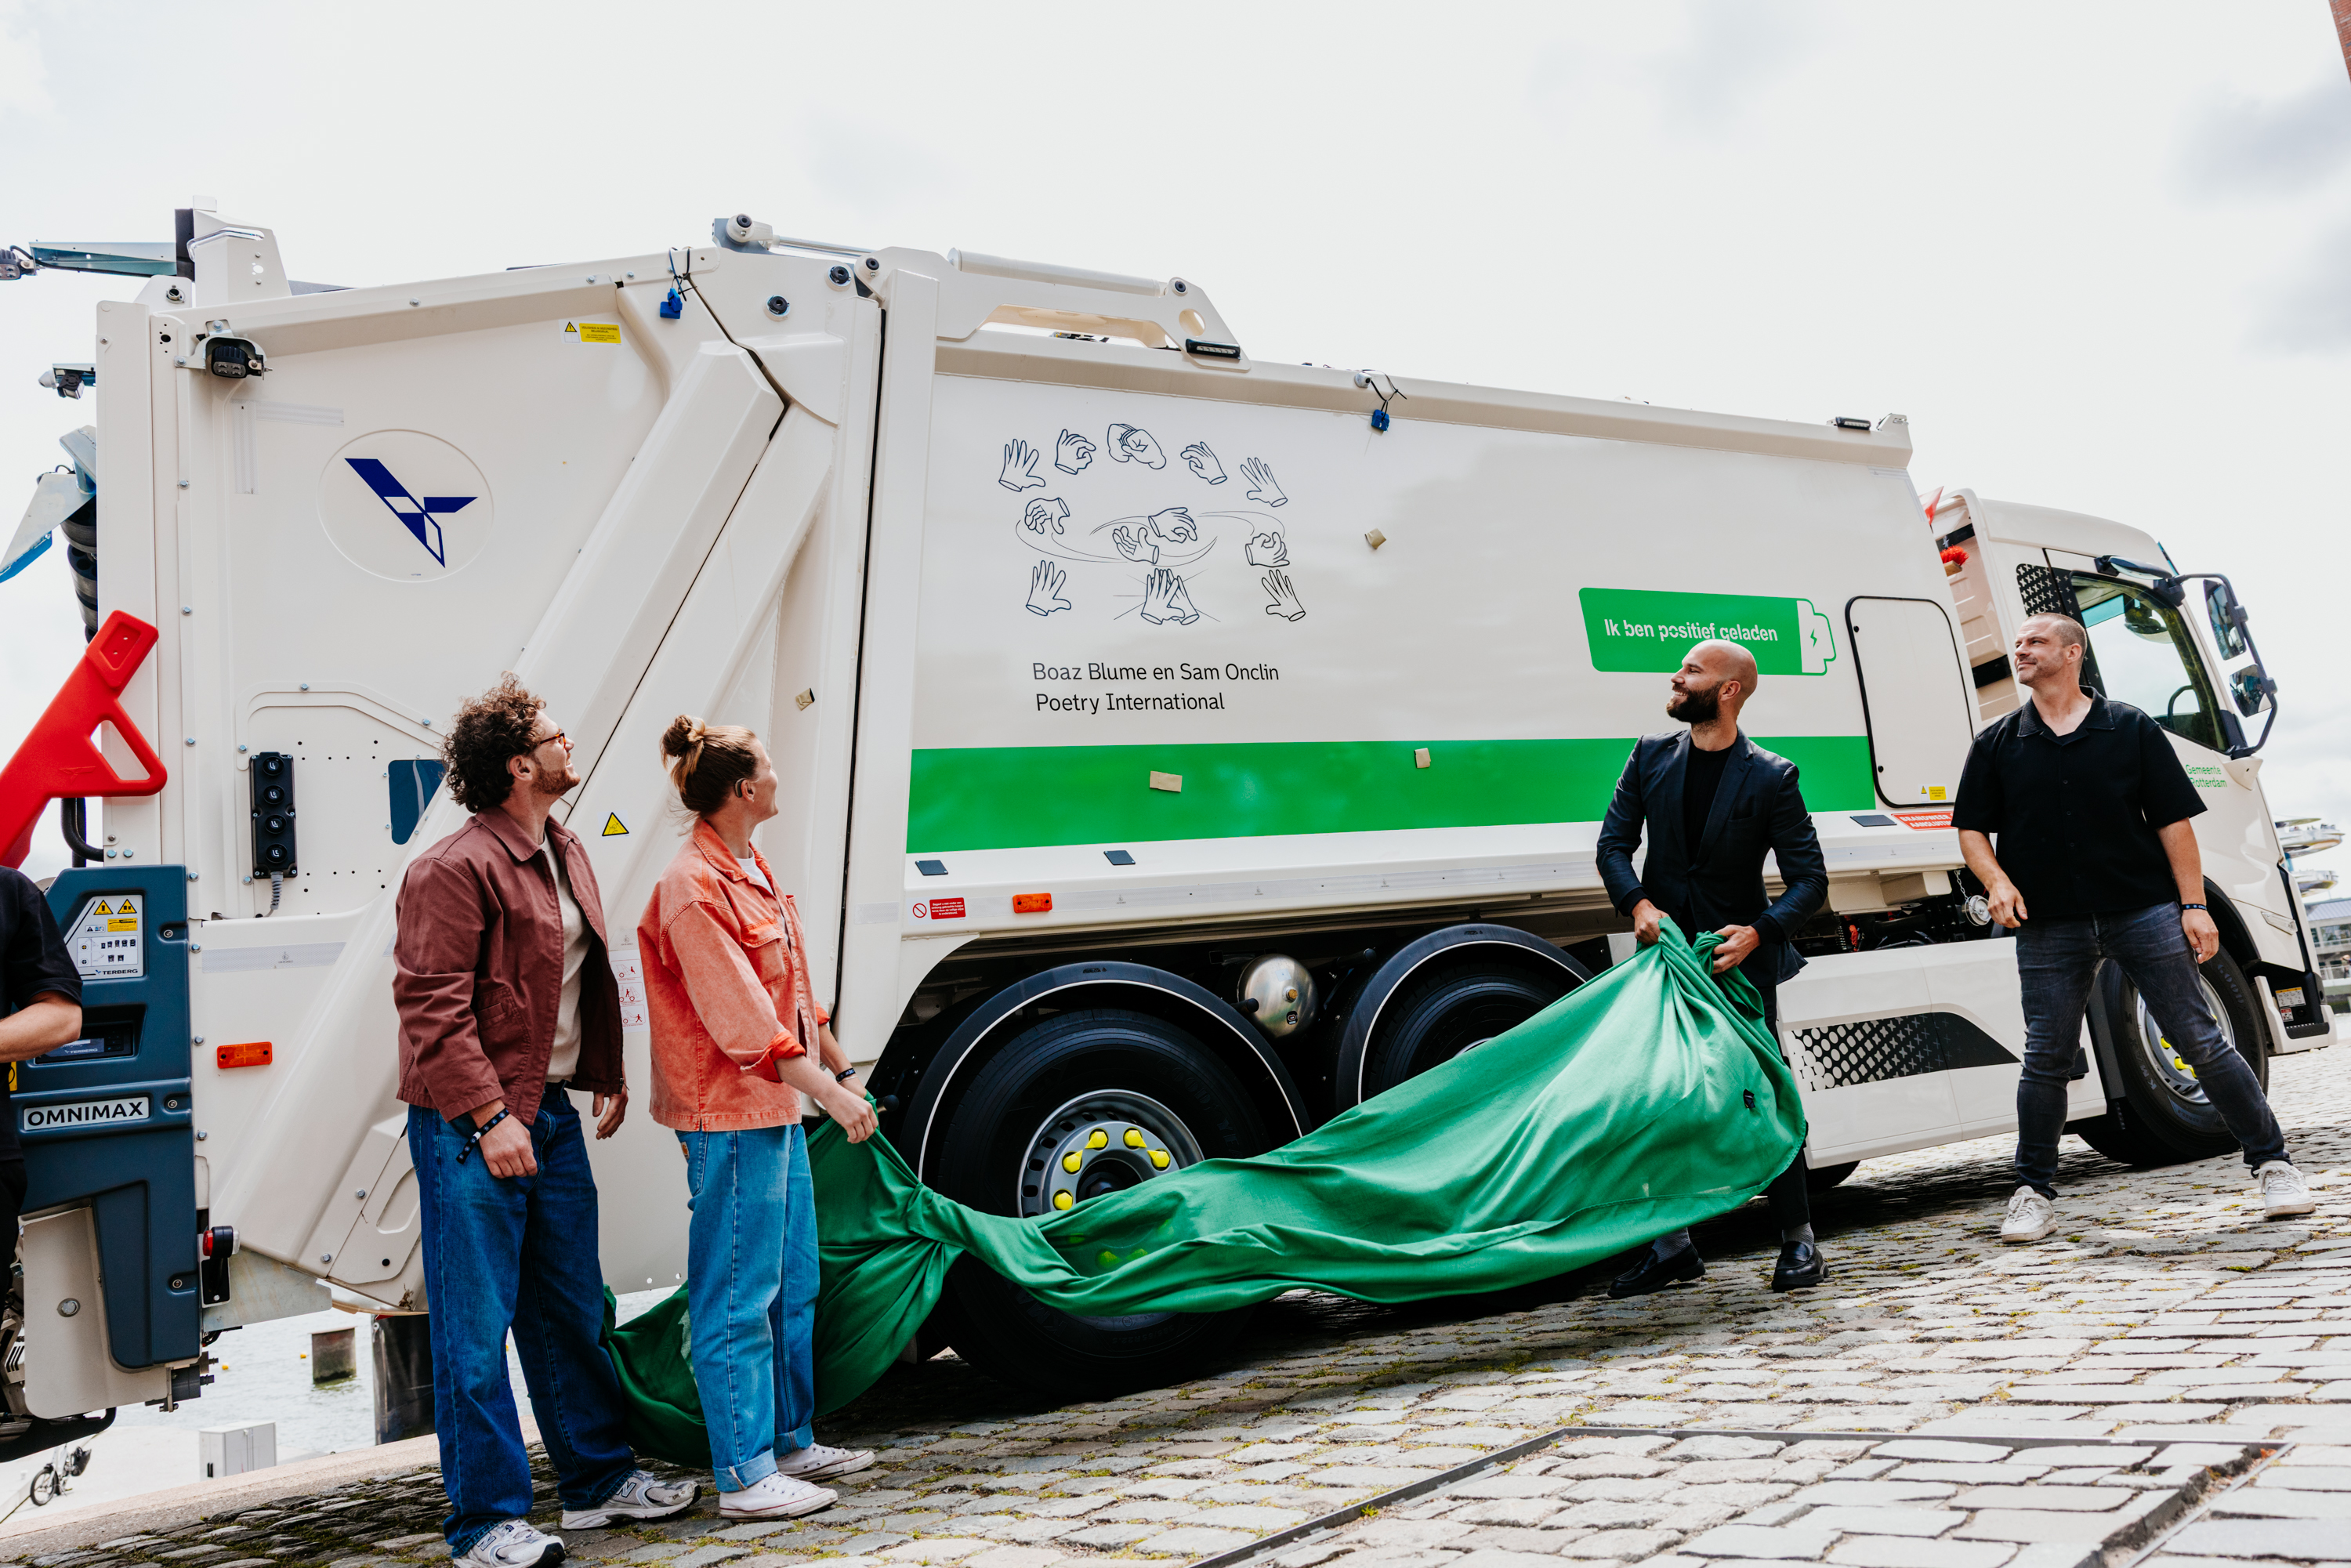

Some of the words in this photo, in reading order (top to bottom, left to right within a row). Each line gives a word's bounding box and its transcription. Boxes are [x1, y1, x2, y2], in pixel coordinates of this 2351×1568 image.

[1604, 618, 1621, 636] Ik
[1623, 619, 1654, 637] ben
[1658, 621, 1715, 642] positief
[1719, 624, 1778, 641] geladen
[1033, 662, 1082, 680] Boaz
[1088, 662, 1147, 680] Blume
[1153, 667, 1174, 680] en
[1180, 663, 1219, 680] Sam
[1225, 663, 1279, 680] Onclin
[1036, 693, 1099, 715] Poetry
[1105, 692, 1225, 710] International
[2186, 764, 2222, 774] Gemeente
[2190, 777, 2227, 788] Rotterdam
[28, 1101, 143, 1126] OMNIMAX
[1156, 1059, 1244, 1158] GOODYEA
